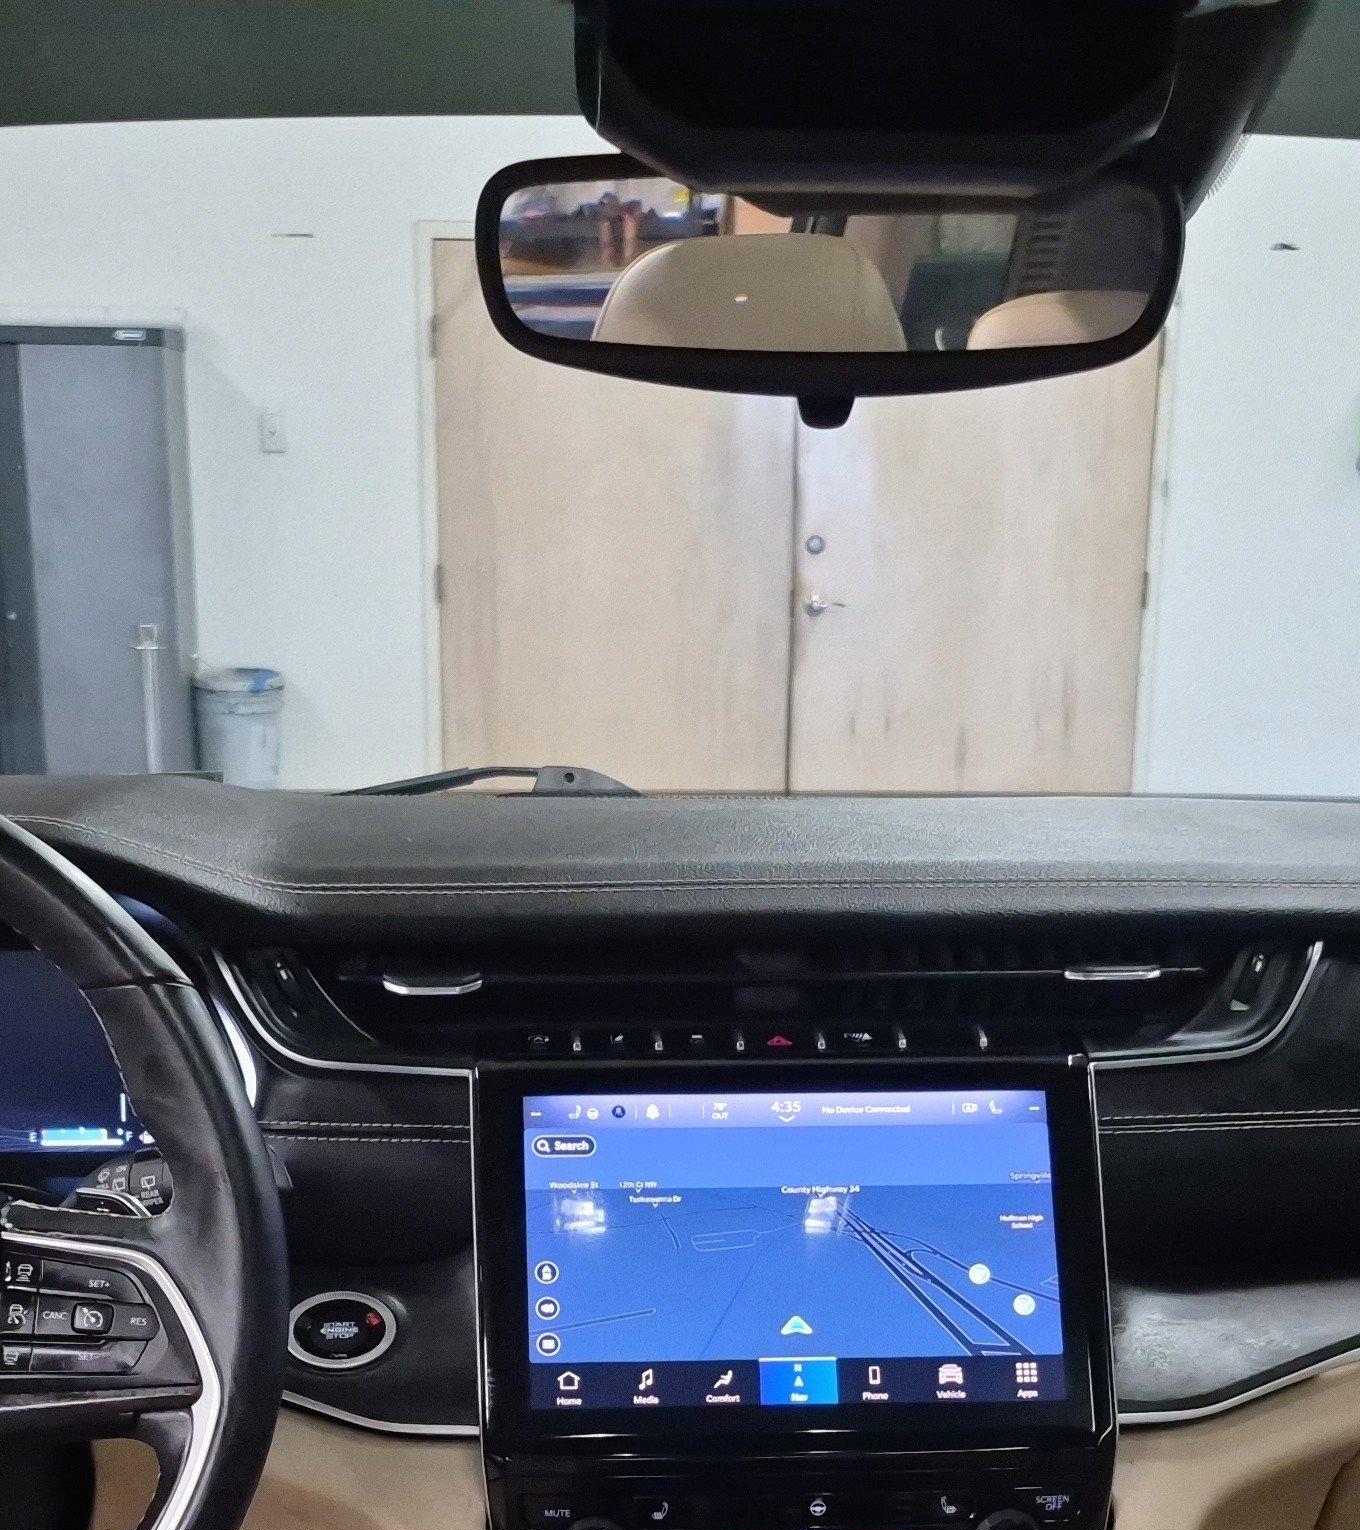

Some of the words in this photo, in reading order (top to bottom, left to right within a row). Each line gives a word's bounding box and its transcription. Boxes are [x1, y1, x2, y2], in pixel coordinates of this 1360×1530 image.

[770, 1100, 802, 1113] 4:35
[821, 1106, 835, 1114] No
[835, 1105, 864, 1114] Device
[864, 1104, 911, 1114] Connected
[711, 1112, 729, 1120] OUT
[28, 1131, 37, 1143] E
[125, 1131, 133, 1142] F
[554, 1140, 589, 1152] Search
[781, 1185, 810, 1195] County
[811, 1184, 848, 1195] Highway
[672, 1195, 682, 1203] Dr
[42, 1310, 69, 1321] CANC
[130, 1317, 148, 1326] RES
[705, 1393, 741, 1404] Comfort
[791, 1393, 808, 1402] Nav
[862, 1390, 889, 1401] Phone
[936, 1389, 967, 1399] Vehicle
[1017, 1388, 1039, 1399] Apps
[556, 1396, 582, 1406] Home
[633, 1395, 660, 1405] Media
[1035, 1494, 1070, 1505] SCREEN
[1045, 1503, 1062, 1511] OFF
[544, 1509, 571, 1518] MUTE
